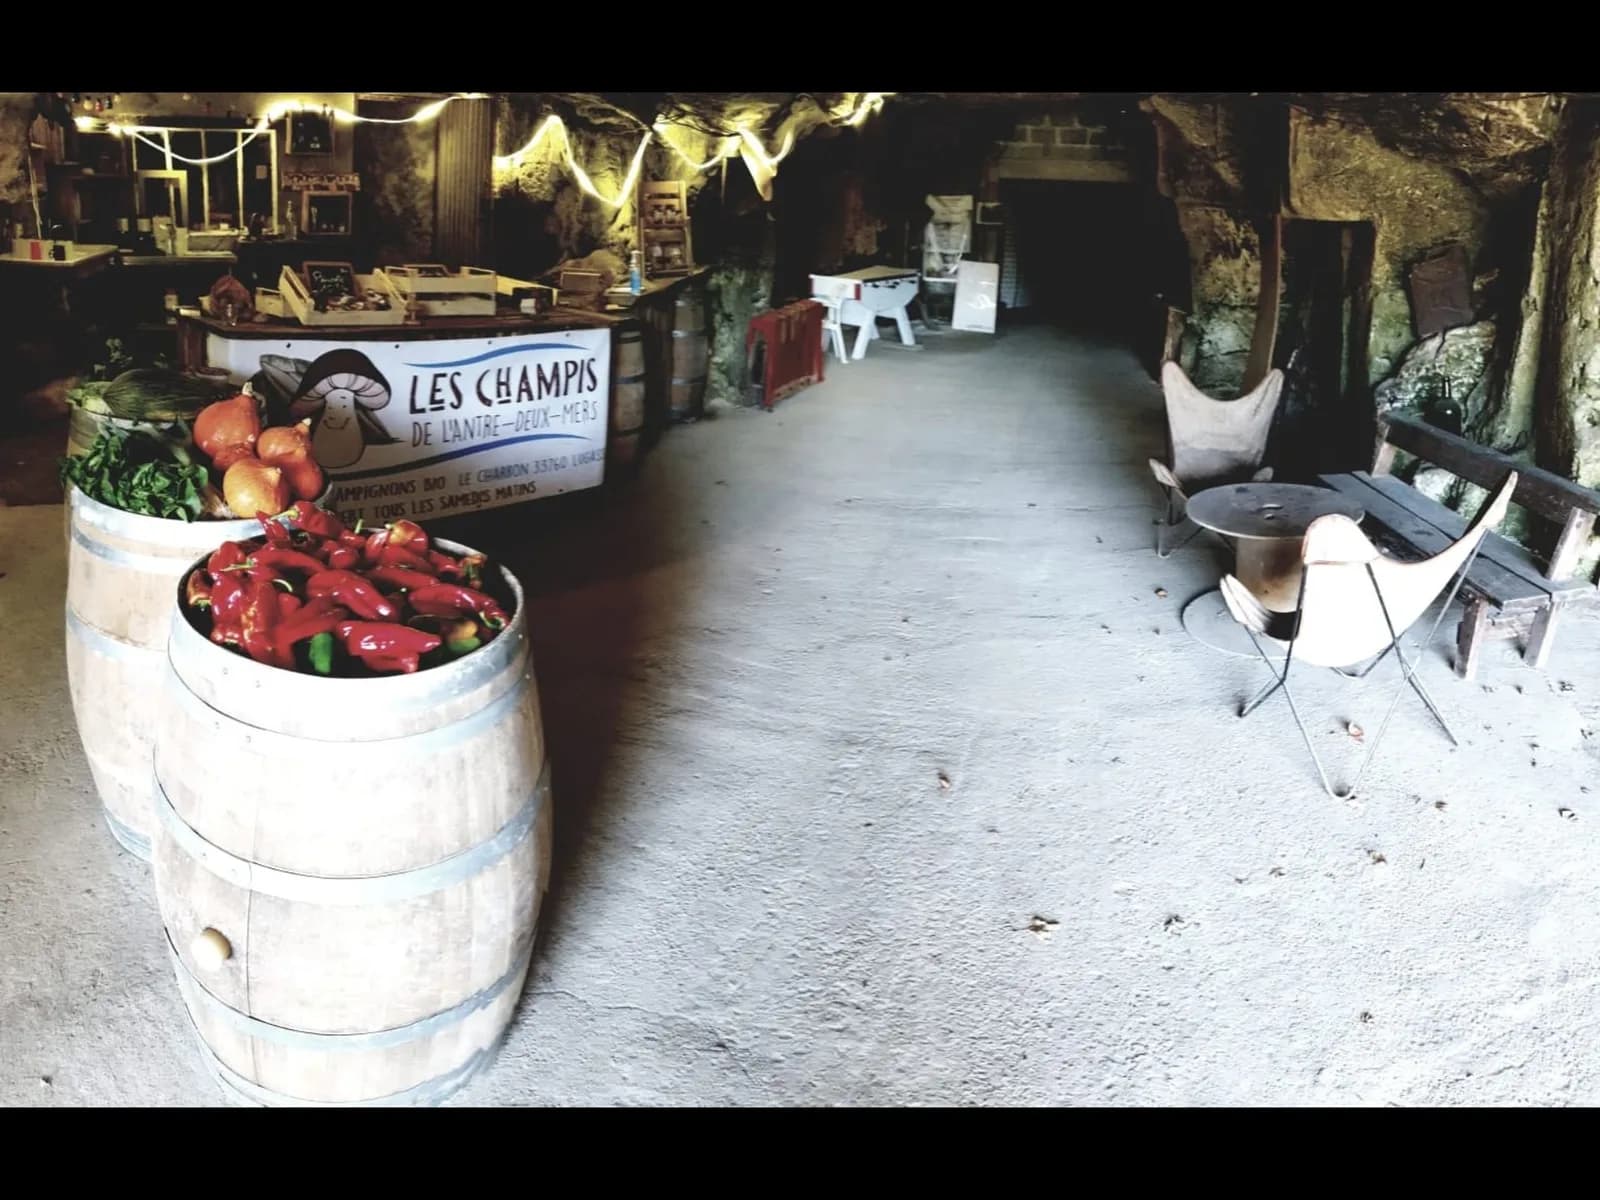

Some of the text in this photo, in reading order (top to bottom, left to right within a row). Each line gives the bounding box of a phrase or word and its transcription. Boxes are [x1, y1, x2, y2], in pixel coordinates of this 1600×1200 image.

[409, 357, 598, 415] LES CHAMPIS
[412, 421, 433, 448] DE
[335, 480, 417, 502] AMPIGNONS
[424, 476, 446, 492] BIO
[374, 502, 407, 519] TOUS
[412, 498, 434, 515] LES
[440, 489, 491, 510] SAMEDIS
[496, 480, 537, 500] MATINS
